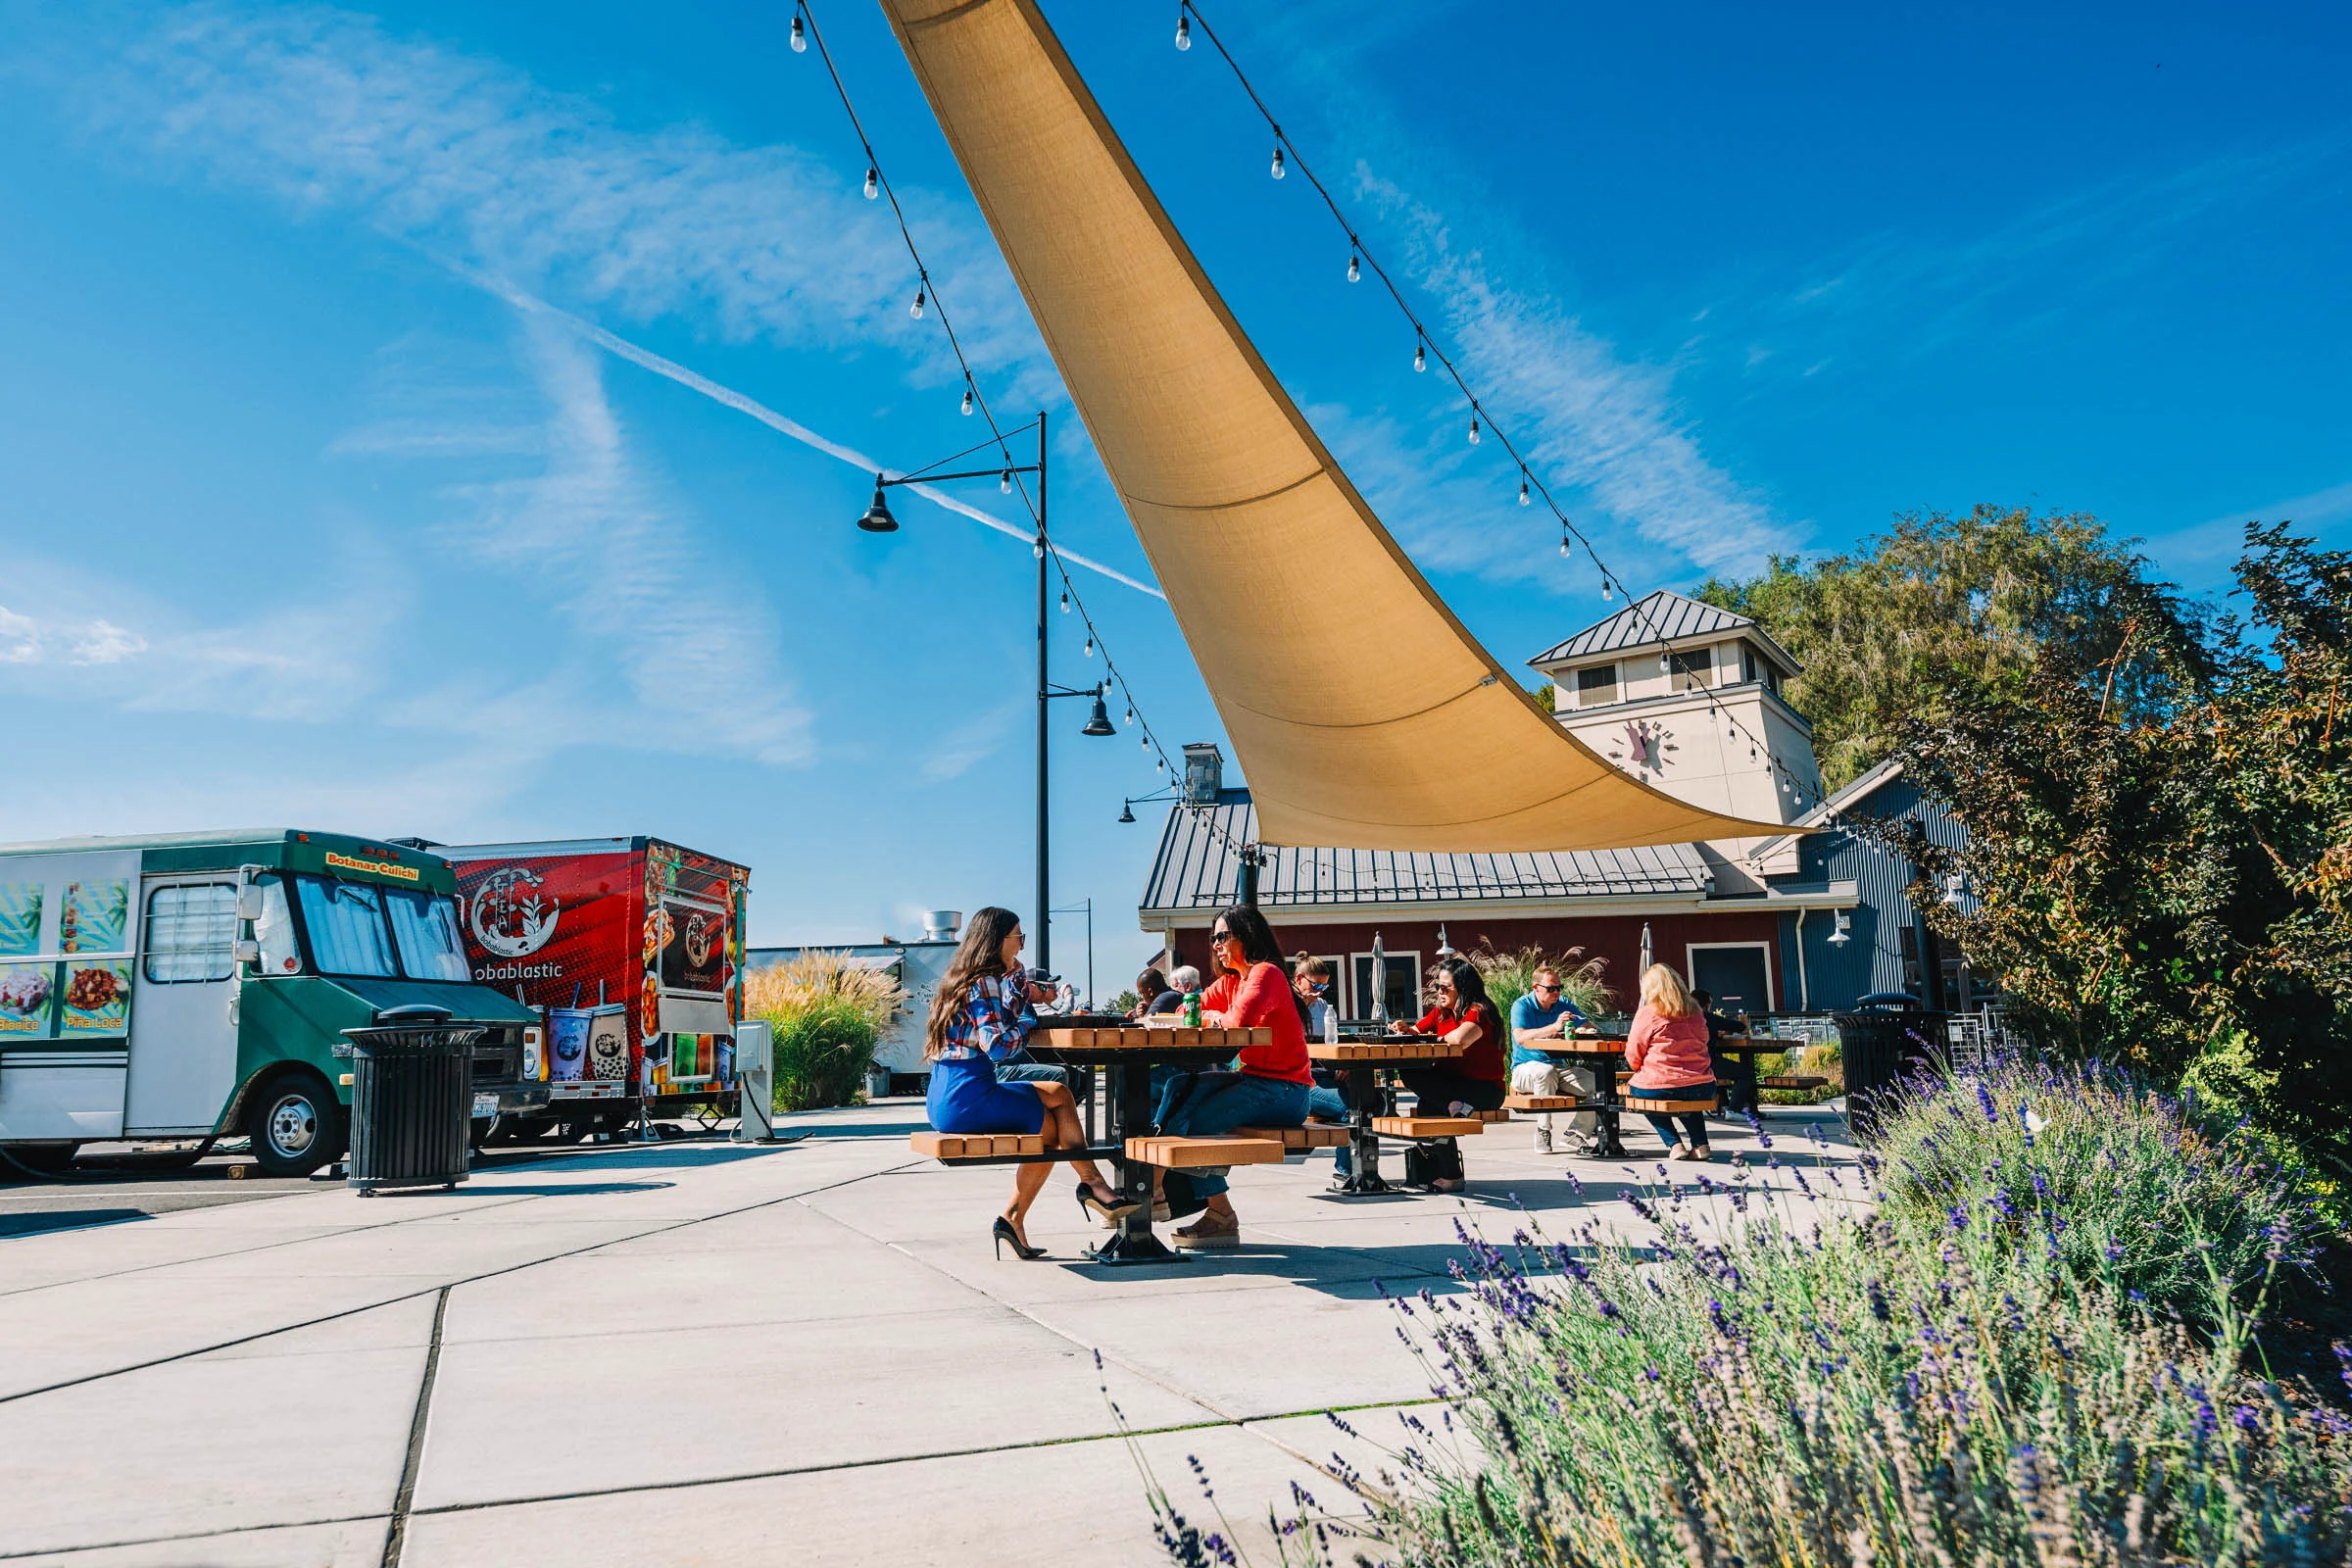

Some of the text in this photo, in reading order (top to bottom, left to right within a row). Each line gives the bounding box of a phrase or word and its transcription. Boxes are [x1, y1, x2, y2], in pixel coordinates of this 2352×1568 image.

[328, 854, 417, 879] Botanas Culichi
[474, 962, 563, 980] obablastic
[66, 1015, 123, 1029] Piña Loca
